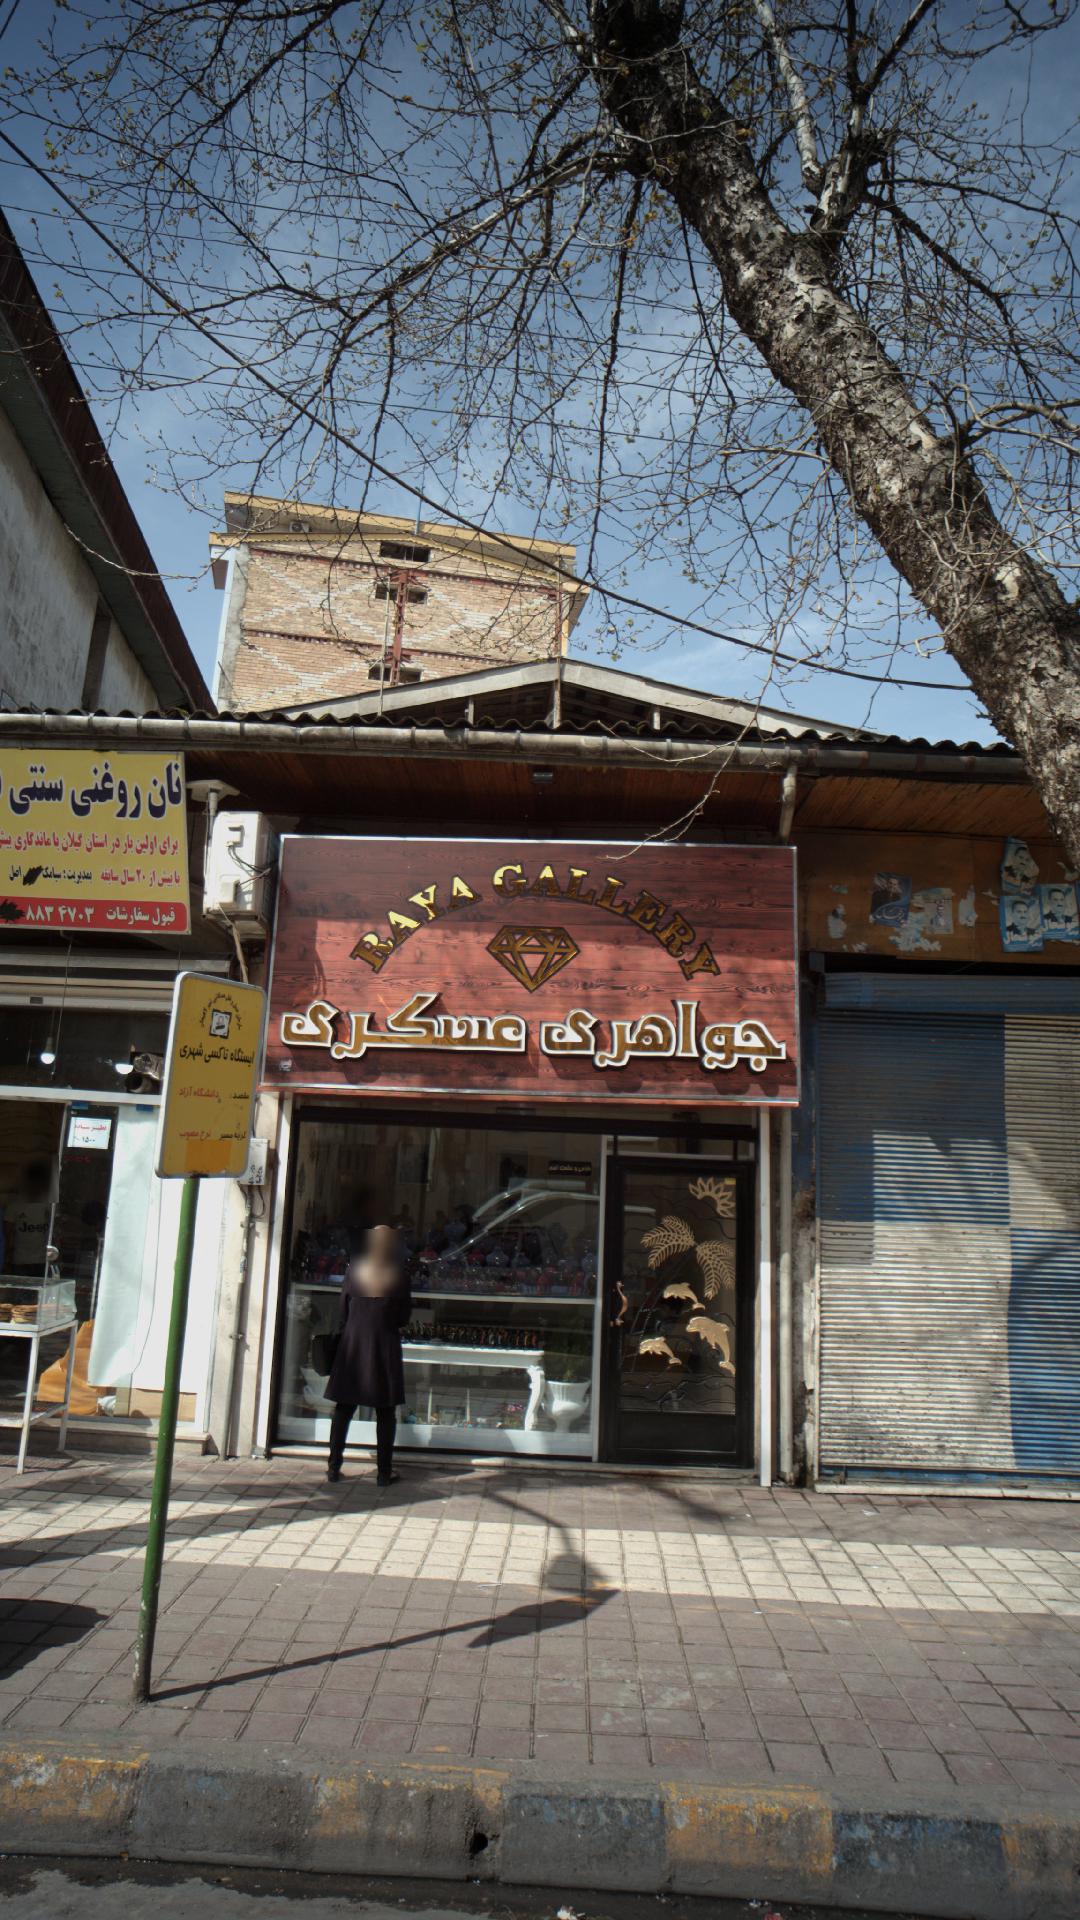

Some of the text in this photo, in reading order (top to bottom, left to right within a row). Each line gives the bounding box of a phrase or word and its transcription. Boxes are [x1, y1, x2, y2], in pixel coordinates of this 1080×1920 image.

[9, 765, 64, 815] سنتی
[71, 762, 141, 818] روغنی
[148, 762, 182, 818] نان
[14, 831, 51, 851] ماندگاری
[53, 831, 59, 850] با
[62, 831, 82, 852] گیلان
[86, 832, 107, 853] استان
[110, 837, 120, 854] در
[122, 834, 134, 854] بار
[135, 834, 157, 855] اولین
[159, 835, 179, 855] برای
[100, 868, 119, 885] سابقه
[120, 868, 135, 886] سال
[148, 870, 156, 887] از
[157, 871, 173, 887] بیش
[174, 870, 180, 884] با
[106, 906, 149, 925] سفارشات
[152, 906, 176, 926] قبول
[350, 864, 722, 981] RAYA GALLERY
[281, 992, 525, 1060] عسکری
[540, 1000, 787, 1072] جواهری
[180, 1042, 255, 1067] ایستگاه تاکسی شهری
[178, 1086, 193, 1098] آزاد
[193, 1088, 220, 1099] دانشگاه
